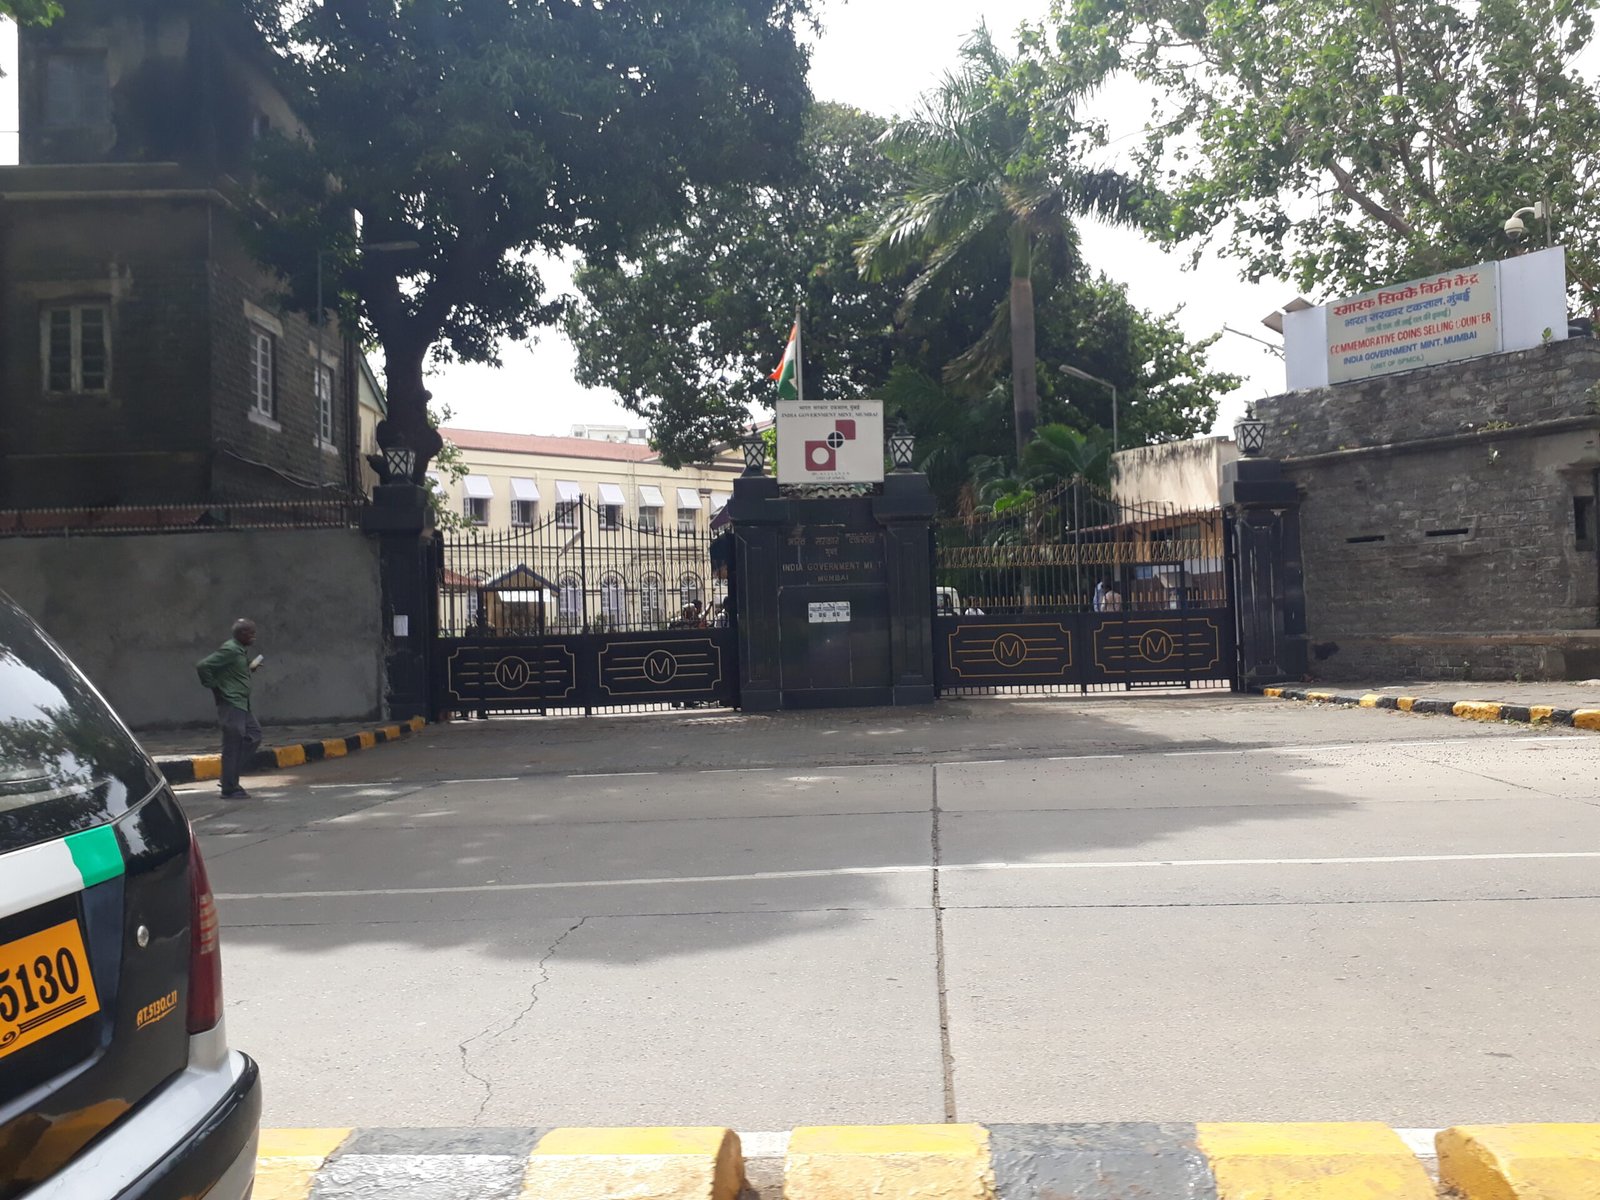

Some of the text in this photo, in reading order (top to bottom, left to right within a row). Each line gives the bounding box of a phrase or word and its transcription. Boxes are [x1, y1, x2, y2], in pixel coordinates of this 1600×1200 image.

[1333, 298, 1376, 316] स्मारक
[1344, 315, 1368, 328] भारत
[1369, 306, 1404, 321] सरकार
[1330, 332, 1396, 355] COMMEMORATIVE
[1397, 327, 1422, 341] COINS
[1423, 320, 1454, 335] SELLING
[1344, 354, 1364, 365] INDIA
[1365, 343, 1418, 361] GOVERNMENT
[1444, 330, 1478, 345] MUMBAI
[782, 563, 803, 572] INDIA
[807, 562, 860, 571] GOVERNMENT
[817, 574, 849, 582] MUMBAI
[1000, 640, 1020, 659] M
[1146, 636, 1167, 656] M
[502, 664, 523, 683] M
[650, 657, 670, 677] M
[0, 947, 80, 1022] 5130
